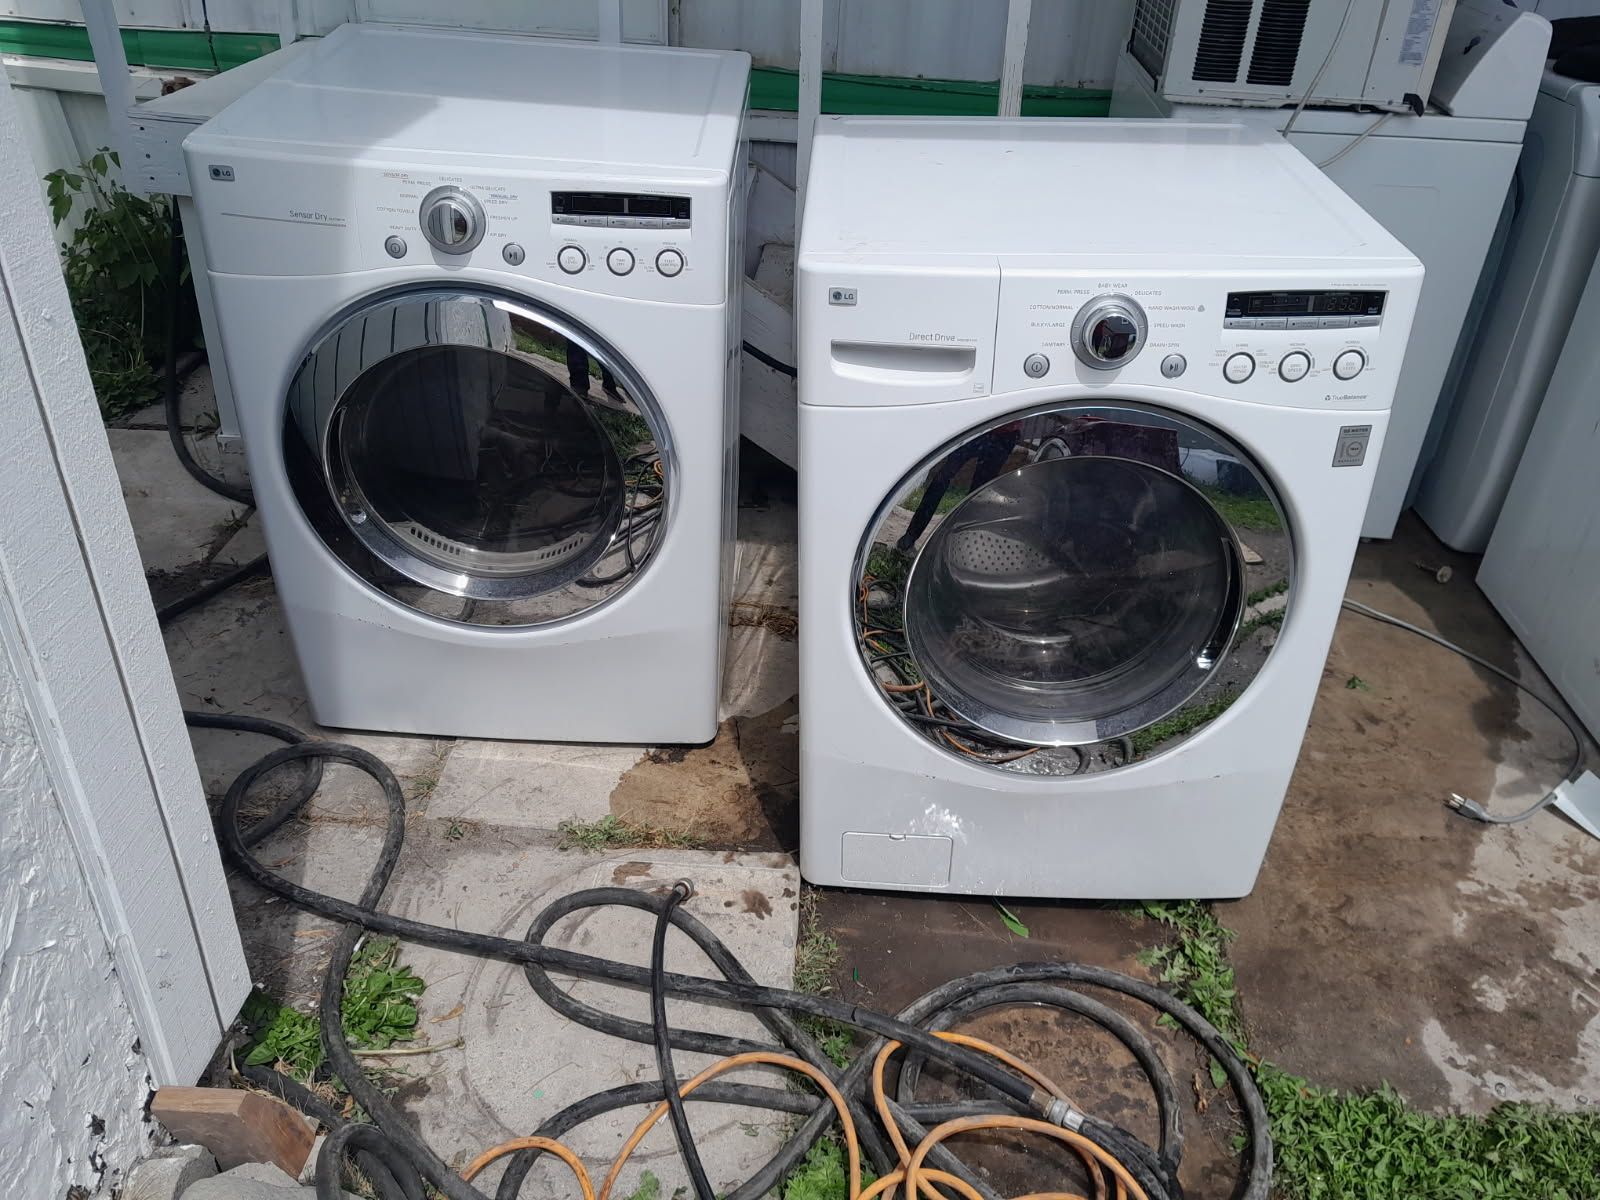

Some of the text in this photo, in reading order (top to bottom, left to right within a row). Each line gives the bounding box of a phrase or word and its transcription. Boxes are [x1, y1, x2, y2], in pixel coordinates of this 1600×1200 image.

[290, 210, 314, 220] Sensor
[314, 212, 328, 221] Dry
[909, 332, 933, 342] Direct
[934, 333, 955, 342] Drive
